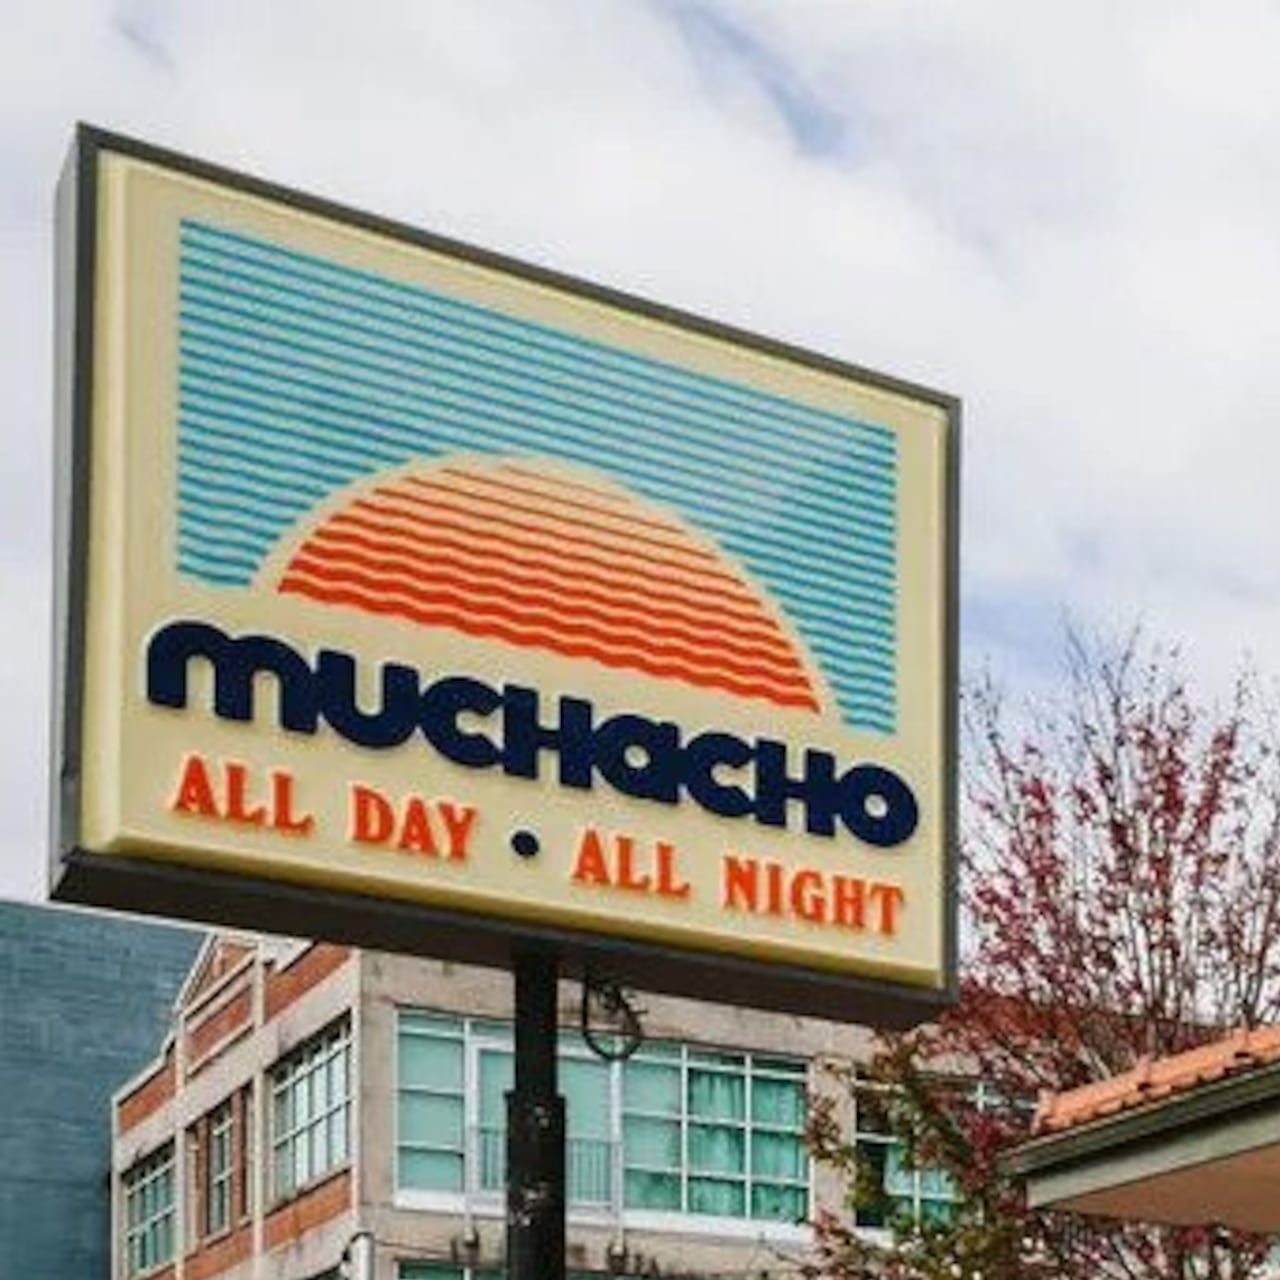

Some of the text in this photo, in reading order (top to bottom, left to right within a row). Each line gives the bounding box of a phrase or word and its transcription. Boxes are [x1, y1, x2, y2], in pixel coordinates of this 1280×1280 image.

[173, 756, 904, 937] ALL DAY ALL NIGHT
